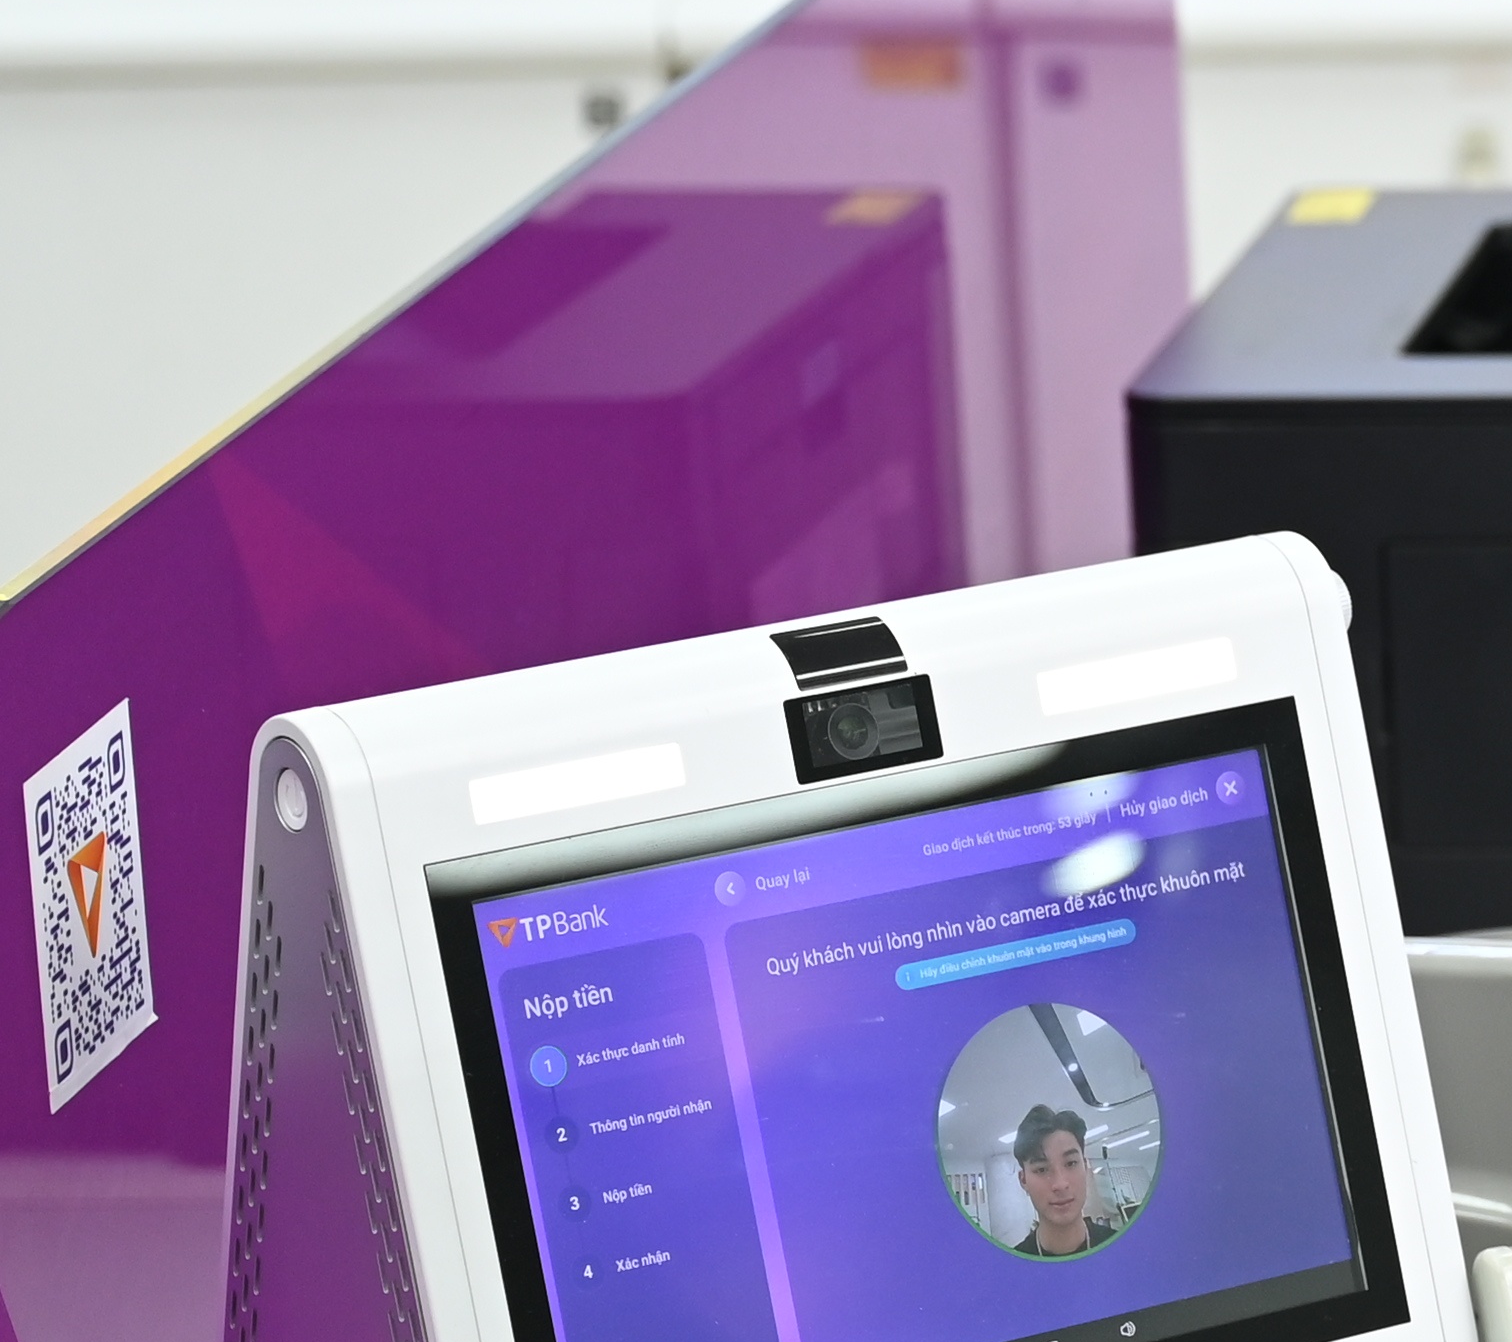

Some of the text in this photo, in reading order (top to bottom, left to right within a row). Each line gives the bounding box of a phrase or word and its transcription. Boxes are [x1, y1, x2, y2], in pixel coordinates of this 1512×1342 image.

[1120, 787, 1209, 818] Hủy giao dịch
[923, 843, 950, 856] Giao
[951, 836, 975, 853] dịch
[976, 830, 995, 846] kết
[996, 825, 1021, 842] thúc
[1058, 816, 1072, 829] 53
[755, 866, 811, 891] Quay lại
[519, 903, 609, 942] TPBank
[766, 951, 800, 976] Quý
[803, 940, 855, 968] khách
[857, 935, 883, 956] vui
[886, 929, 924, 951] lòng
[926, 920, 963, 943] nhìn
[966, 913, 996, 934] vào
[1000, 901, 1061, 928] camera
[1088, 888, 1117, 911] xác
[1119, 881, 1158, 903] thực
[1159, 869, 1211, 894] khuôn
[1214, 861, 1246, 884] mặt
[523, 983, 614, 1020] Nộp tiền
[544, 1033, 685, 1073] 1 Xác thực danh tính
[557, 1098, 712, 1143] 2 Thông tin người nhận
[569, 1182, 653, 1211] 3 Nộp tiền
[583, 1249, 671, 1279] 4 Xác nhận
